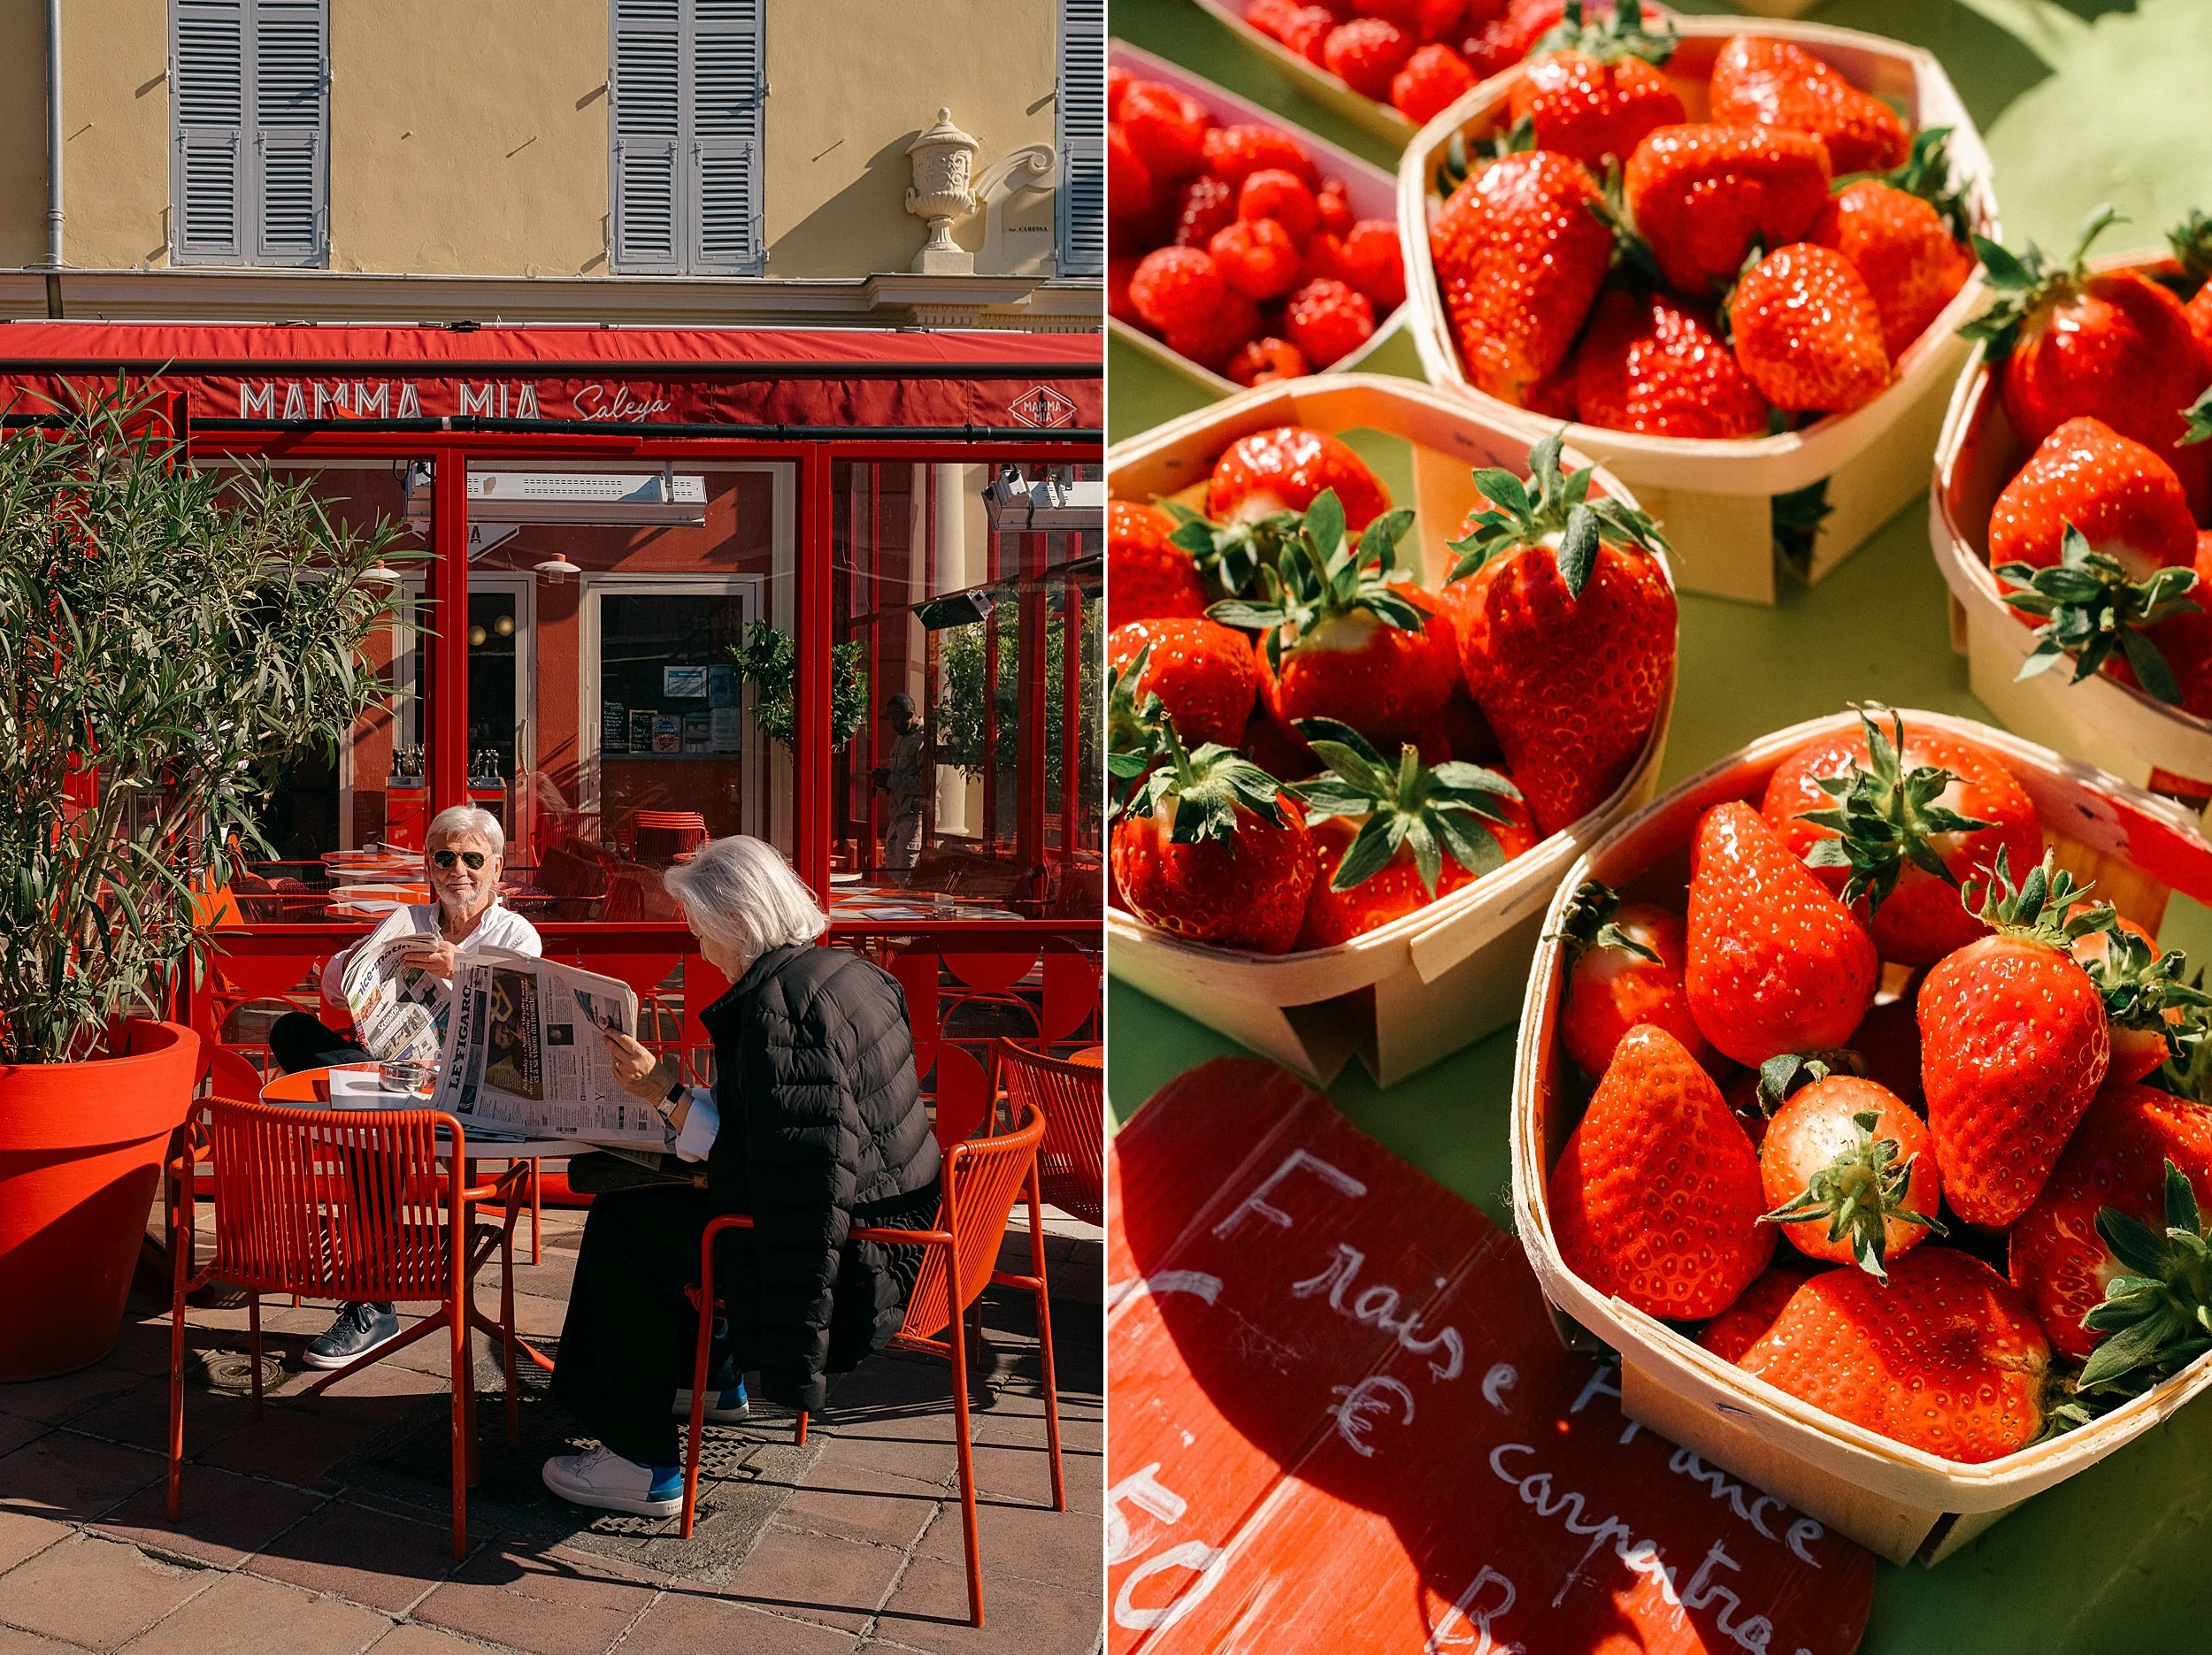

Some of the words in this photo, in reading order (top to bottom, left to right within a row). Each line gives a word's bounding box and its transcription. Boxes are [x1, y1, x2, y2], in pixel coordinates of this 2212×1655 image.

[240, 383, 421, 419] MAMMA
[459, 383, 541, 419] MIA
[573, 384, 672, 422] Saleya
[1024, 401, 1062, 412] MAMMA
[1034, 411, 1053, 422] MIA
[357, 944, 411, 996] nice-matin
[378, 1005, 399, 1032] Scénario
[452, 985, 472, 1062] FIGARO
[529, 1023, 537, 1035] du
[530, 1036, 539, 1058] vision
[449, 1065, 462, 1091] LE
[1212, 1149, 1518, 1415] Fraise
[1489, 1444, 1812, 1655] carpentra
